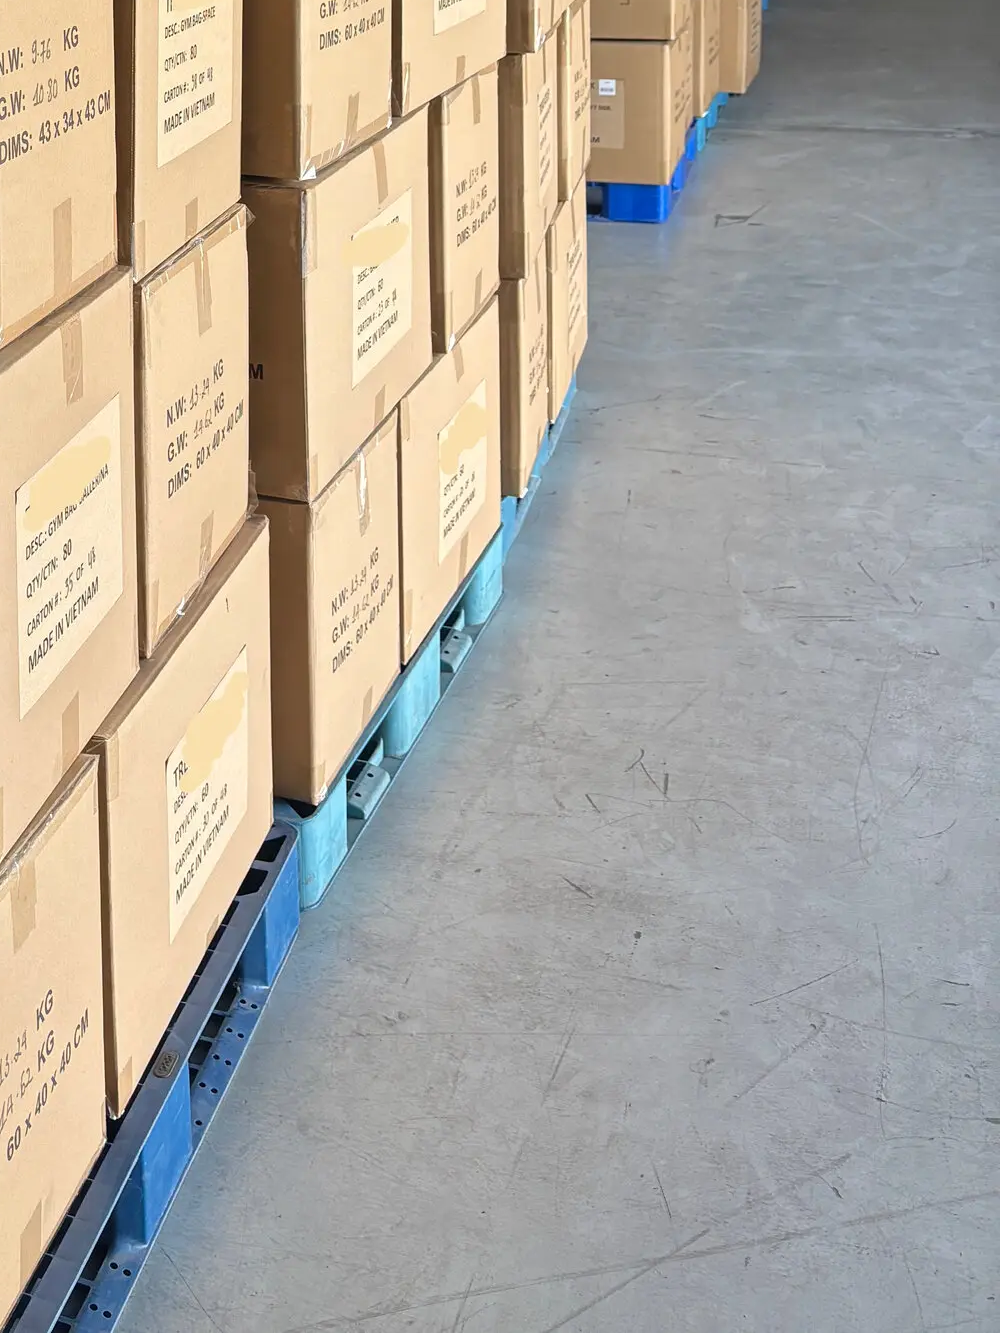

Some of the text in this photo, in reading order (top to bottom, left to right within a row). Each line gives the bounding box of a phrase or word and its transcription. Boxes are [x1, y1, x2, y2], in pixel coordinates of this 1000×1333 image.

[63, 25, 79, 52] KG
[180, 18, 192, 32] GYM
[64, 66, 80, 92] KG
[164, 92, 215, 135] MADE IN VIETNAM
[166, 358, 224, 428] N.W: KG
[48, 511, 64, 537] GYM
[26, 538, 72, 599] QTY/CTN: 80
[332, 547, 379, 616] N.W: KG
[28, 576, 99, 674] MADE IN VIETNAM
[175, 862, 195, 905] MADE
[203, 804, 230, 856] VIETNAM
[36, 989, 53, 1031] KG
